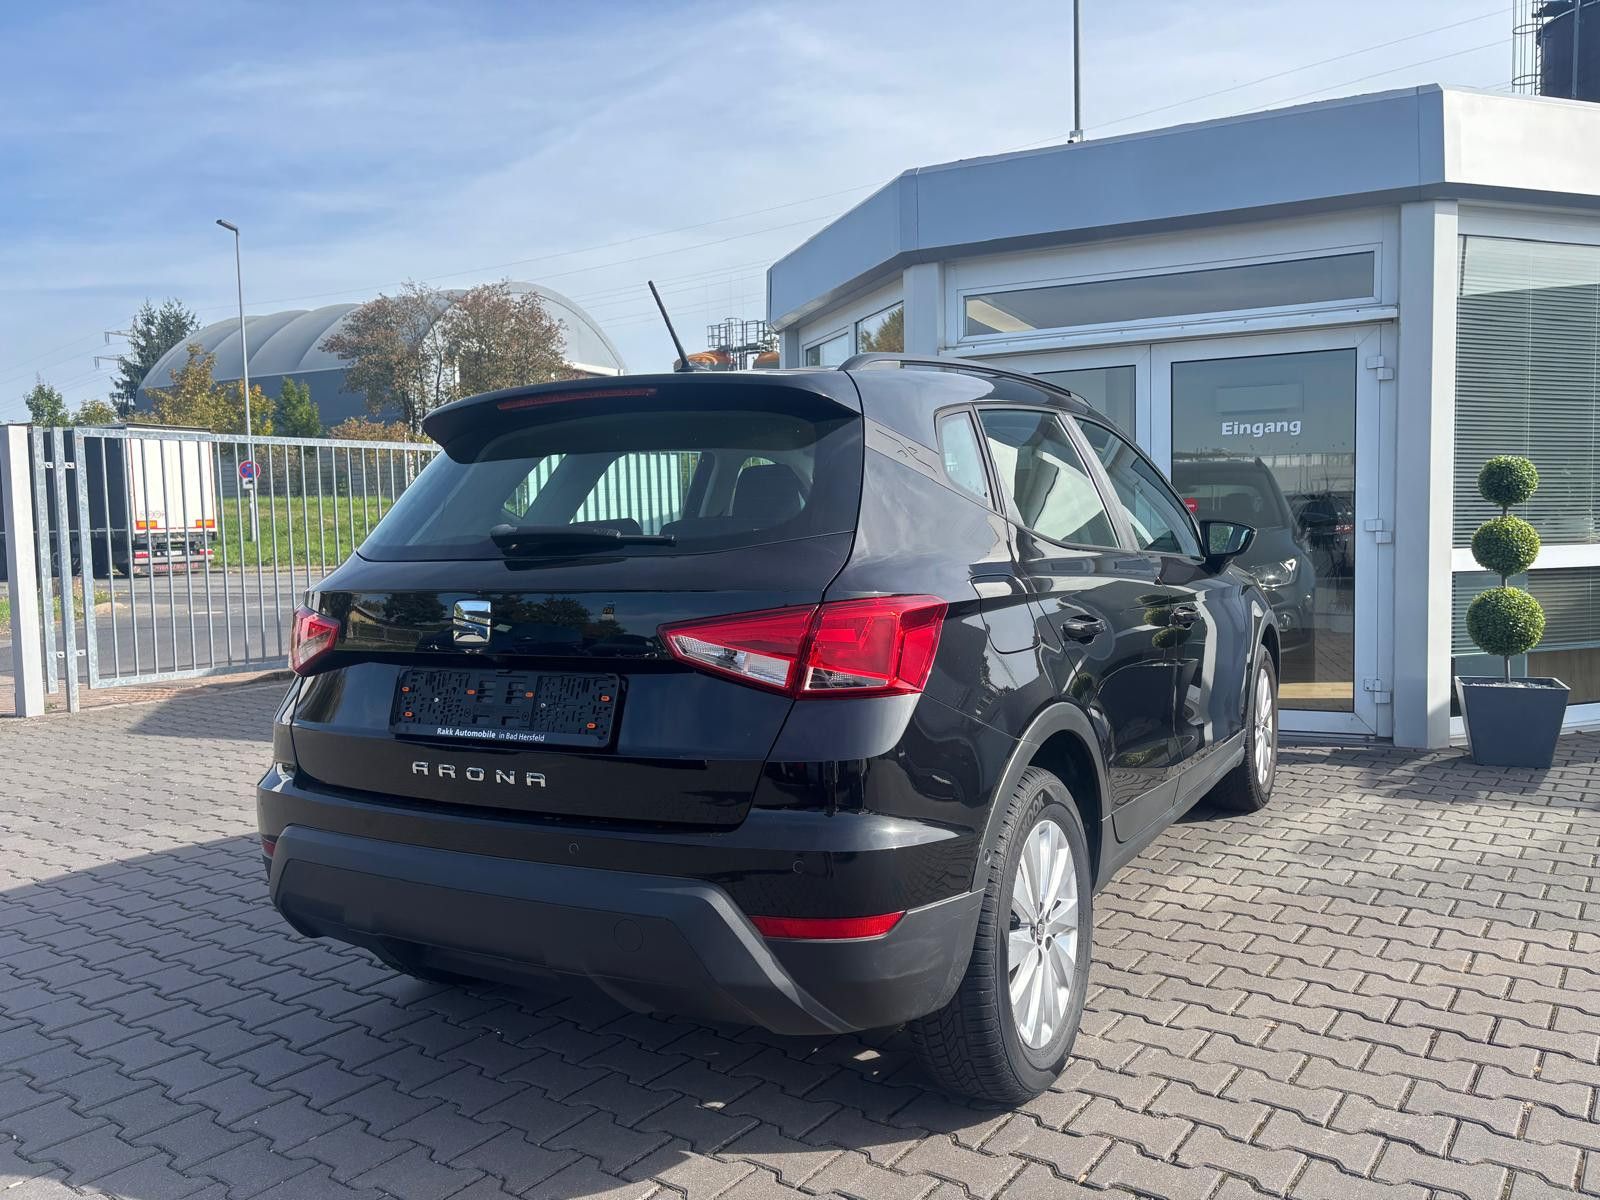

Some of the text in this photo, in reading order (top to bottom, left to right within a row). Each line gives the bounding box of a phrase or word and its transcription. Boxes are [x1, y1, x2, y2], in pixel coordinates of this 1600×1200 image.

[1221, 420, 1302, 437] Eingang
[436, 727, 545, 742] Rakk Automobile in Bad Hersfeld
[411, 761, 546, 787] ARONA
